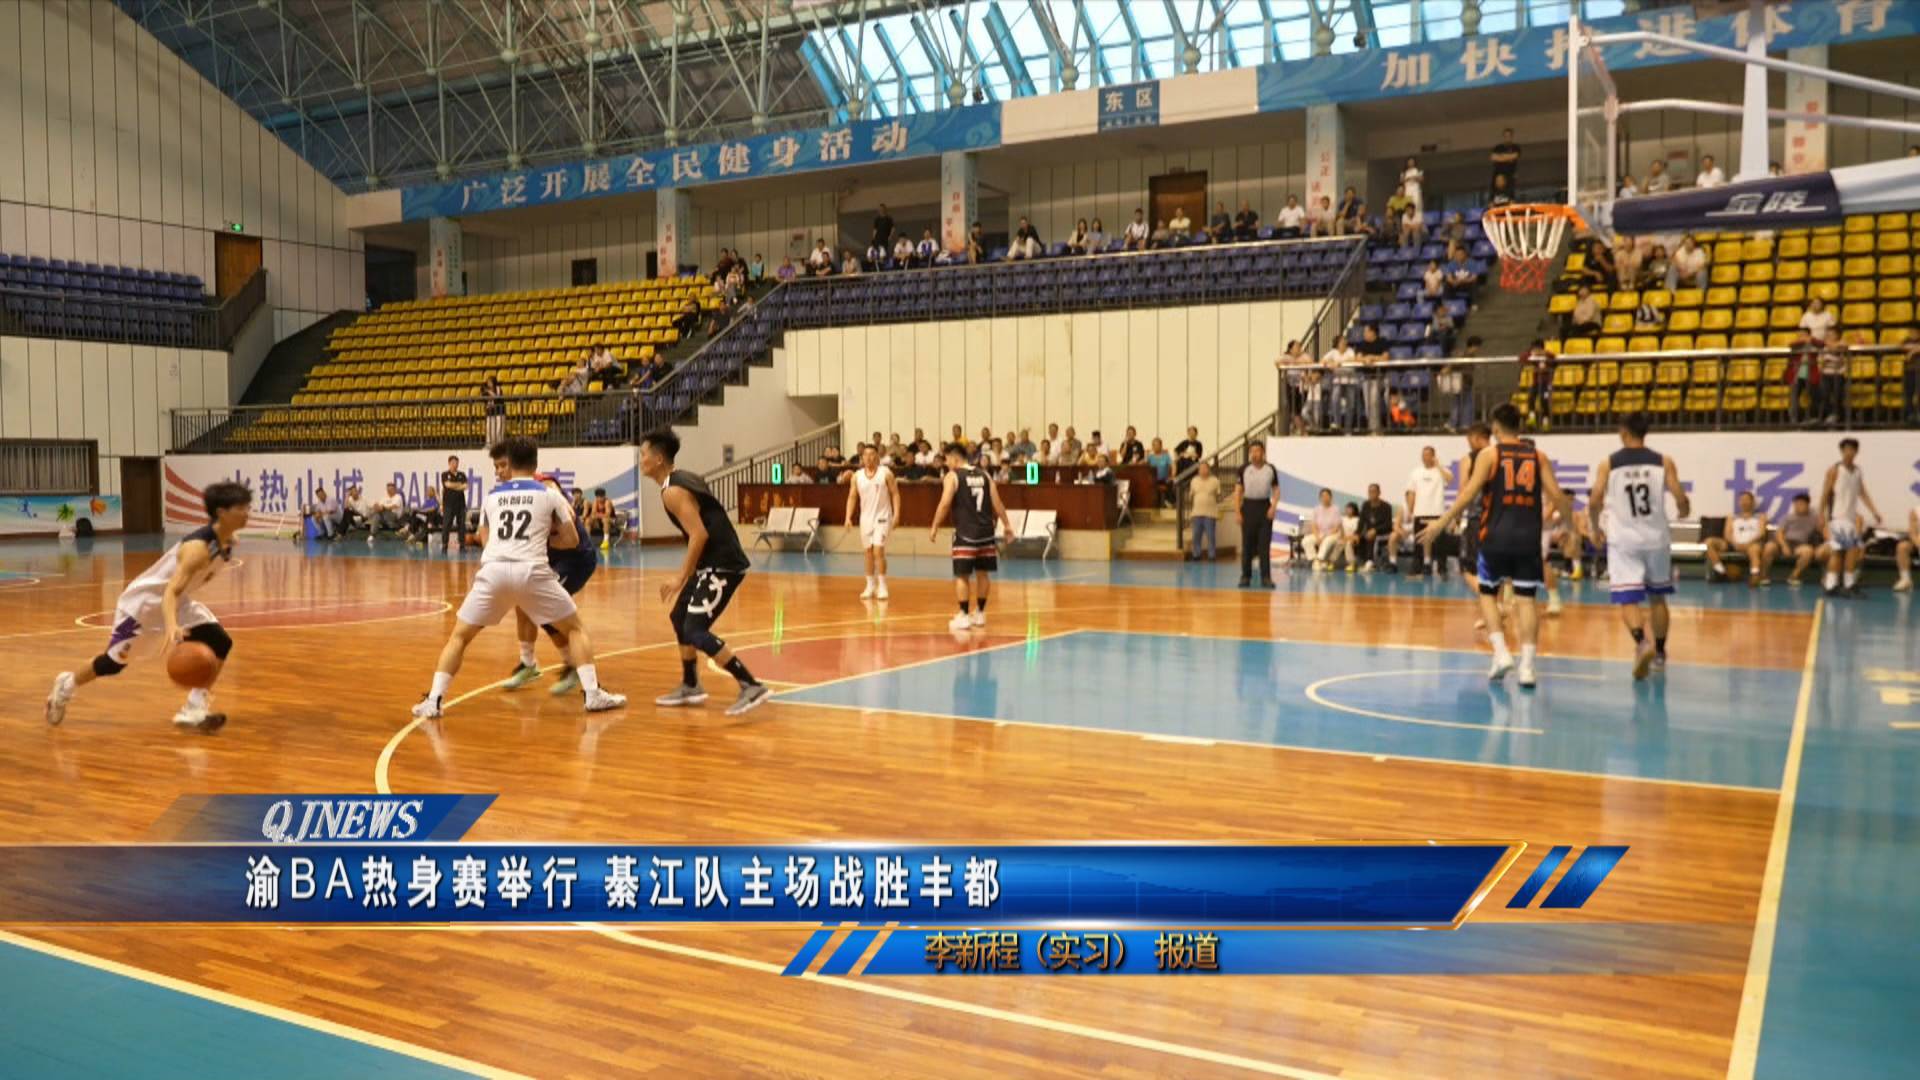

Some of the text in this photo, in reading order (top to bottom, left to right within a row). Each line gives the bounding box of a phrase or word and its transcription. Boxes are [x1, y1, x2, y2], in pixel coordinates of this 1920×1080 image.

[1104, 86, 1153, 113] 东区
[461, 121, 909, 211] 广泛开展全民健身活动
[1725, 190, 1808, 215] 金陵
[1500, 459, 1536, 493] 14
[971, 487, 984, 512] 7
[1624, 483, 1652, 518] 13
[497, 509, 532, 541] 32
